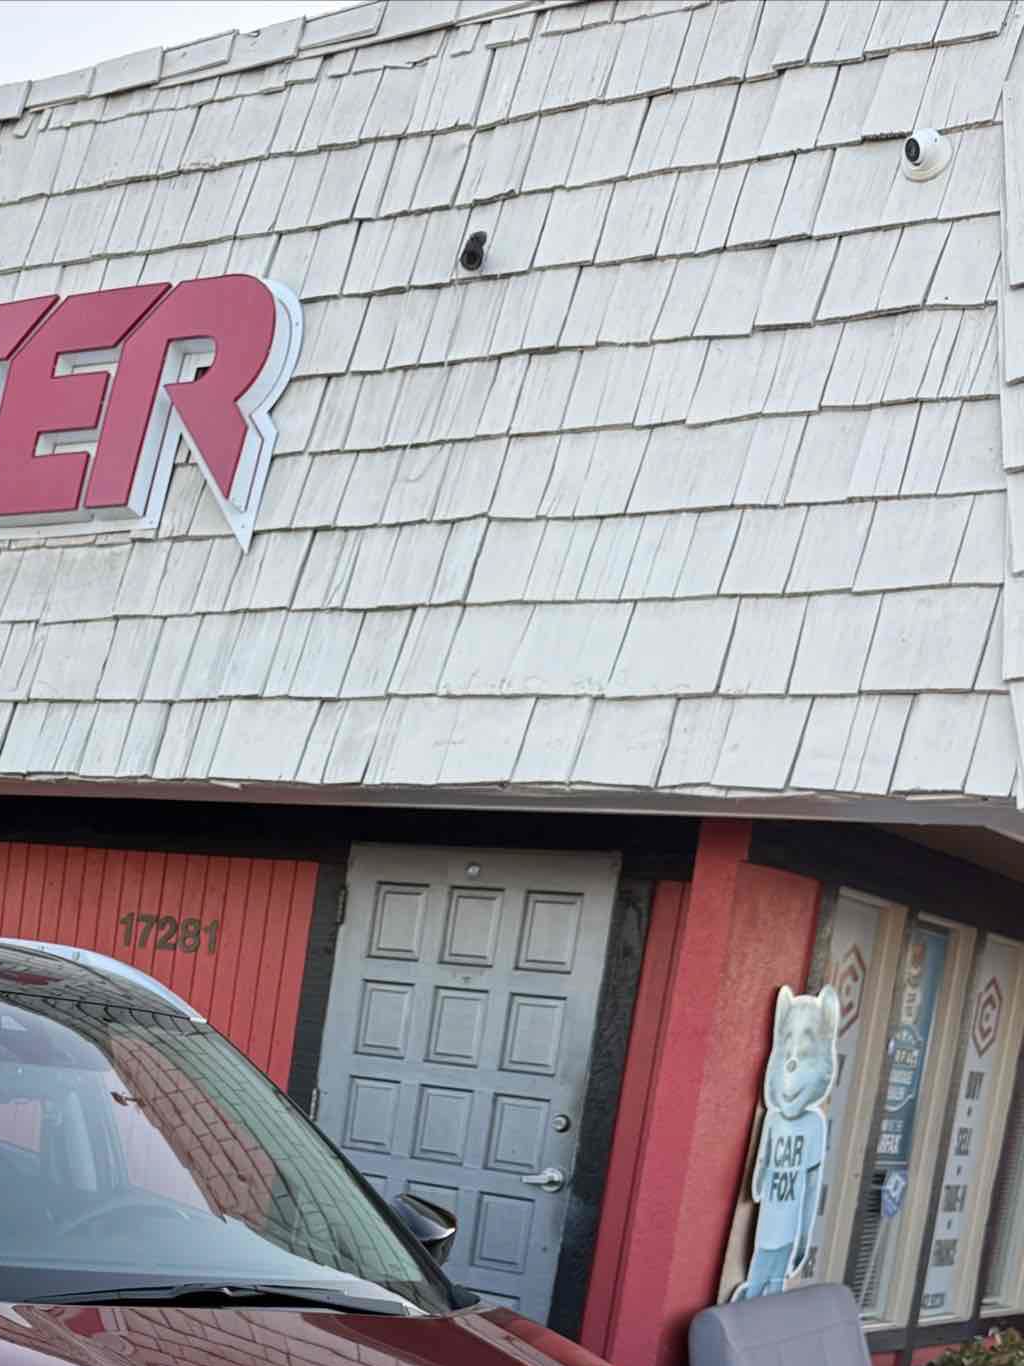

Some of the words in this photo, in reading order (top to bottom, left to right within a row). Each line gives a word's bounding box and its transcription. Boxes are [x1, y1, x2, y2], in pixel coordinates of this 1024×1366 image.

[119, 911, 220, 955] 17281
[773, 1135, 805, 1168] CAR
[769, 1171, 799, 1202] FOX
